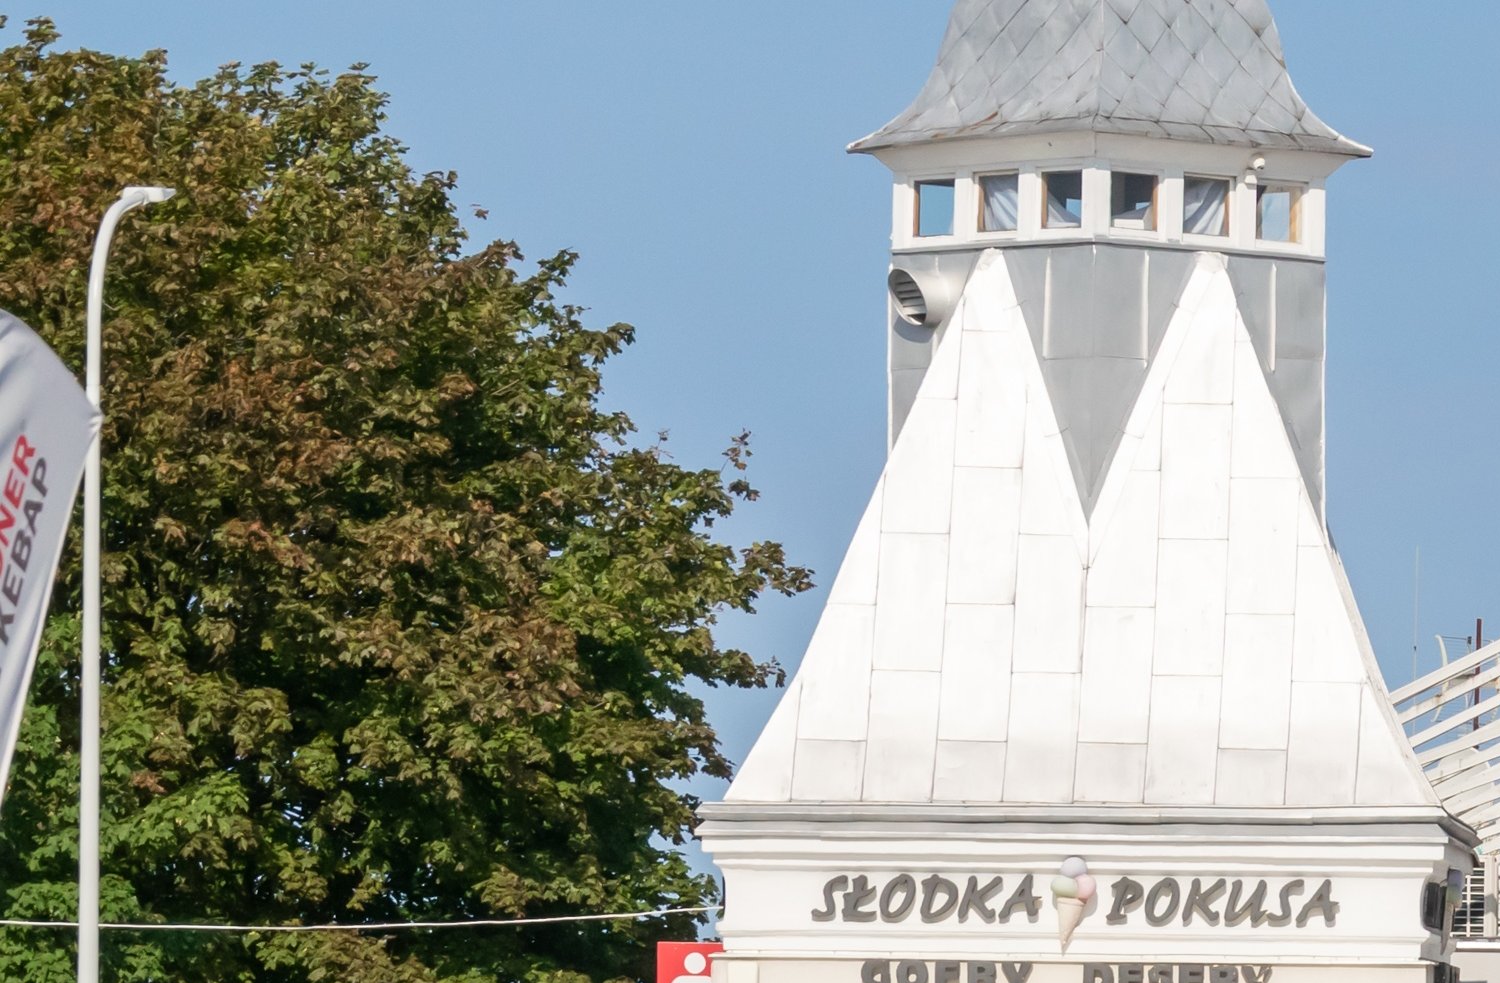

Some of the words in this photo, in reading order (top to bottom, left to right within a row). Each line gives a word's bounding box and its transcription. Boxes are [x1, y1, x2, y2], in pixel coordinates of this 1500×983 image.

[0, 434, 36, 577] NER
[811, 873, 1042, 924] SŁODKA
[1106, 876, 1340, 928] POKUSA
